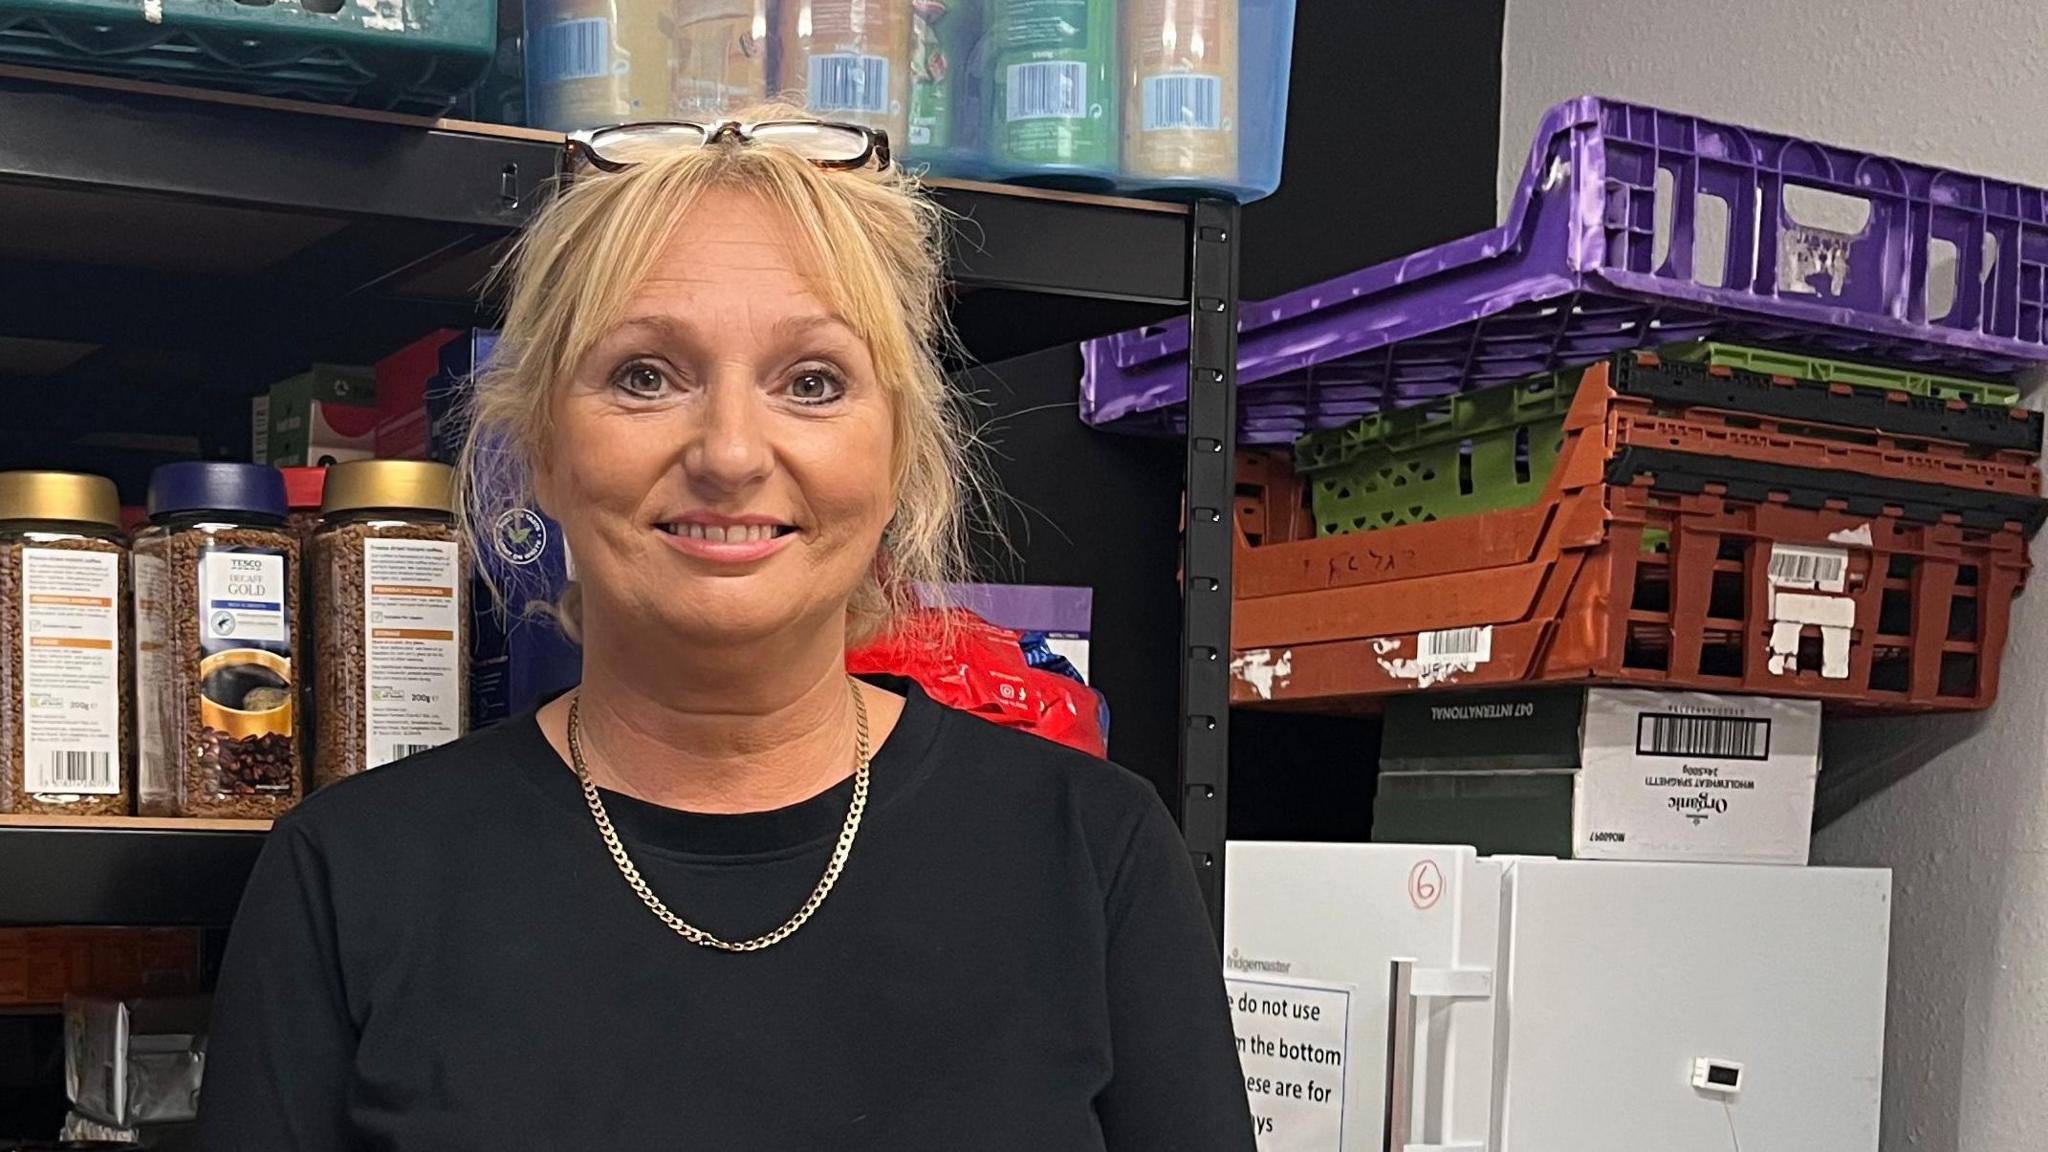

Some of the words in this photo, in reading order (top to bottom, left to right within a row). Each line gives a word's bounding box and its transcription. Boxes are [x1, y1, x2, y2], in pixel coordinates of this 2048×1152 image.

[231, 559, 262, 569] TESCO
[228, 583, 266, 596] GOLD
[1431, 703, 1513, 720] INTERNATIONAL
[1514, 702, 1533, 717] 047
[1682, 764, 1718, 777] 24x500g
[1645, 776, 1692, 787] SPAGHETTI
[1694, 779, 1754, 789] WHOLEWHEAT
[1668, 792, 1728, 814] Organic
[1417, 865, 1435, 899] 6
[1225, 955, 1291, 973] fridgemaster
[1238, 992, 1257, 1013] do
[1262, 1000, 1287, 1017] not
[1293, 1004, 1320, 1021] use
[1251, 1034, 1275, 1057] the
[1279, 1037, 1342, 1066] bottom
[1275, 1081, 1302, 1099] are
[1308, 1080, 1331, 1103] for
[1252, 1115, 1273, 1135] ys
